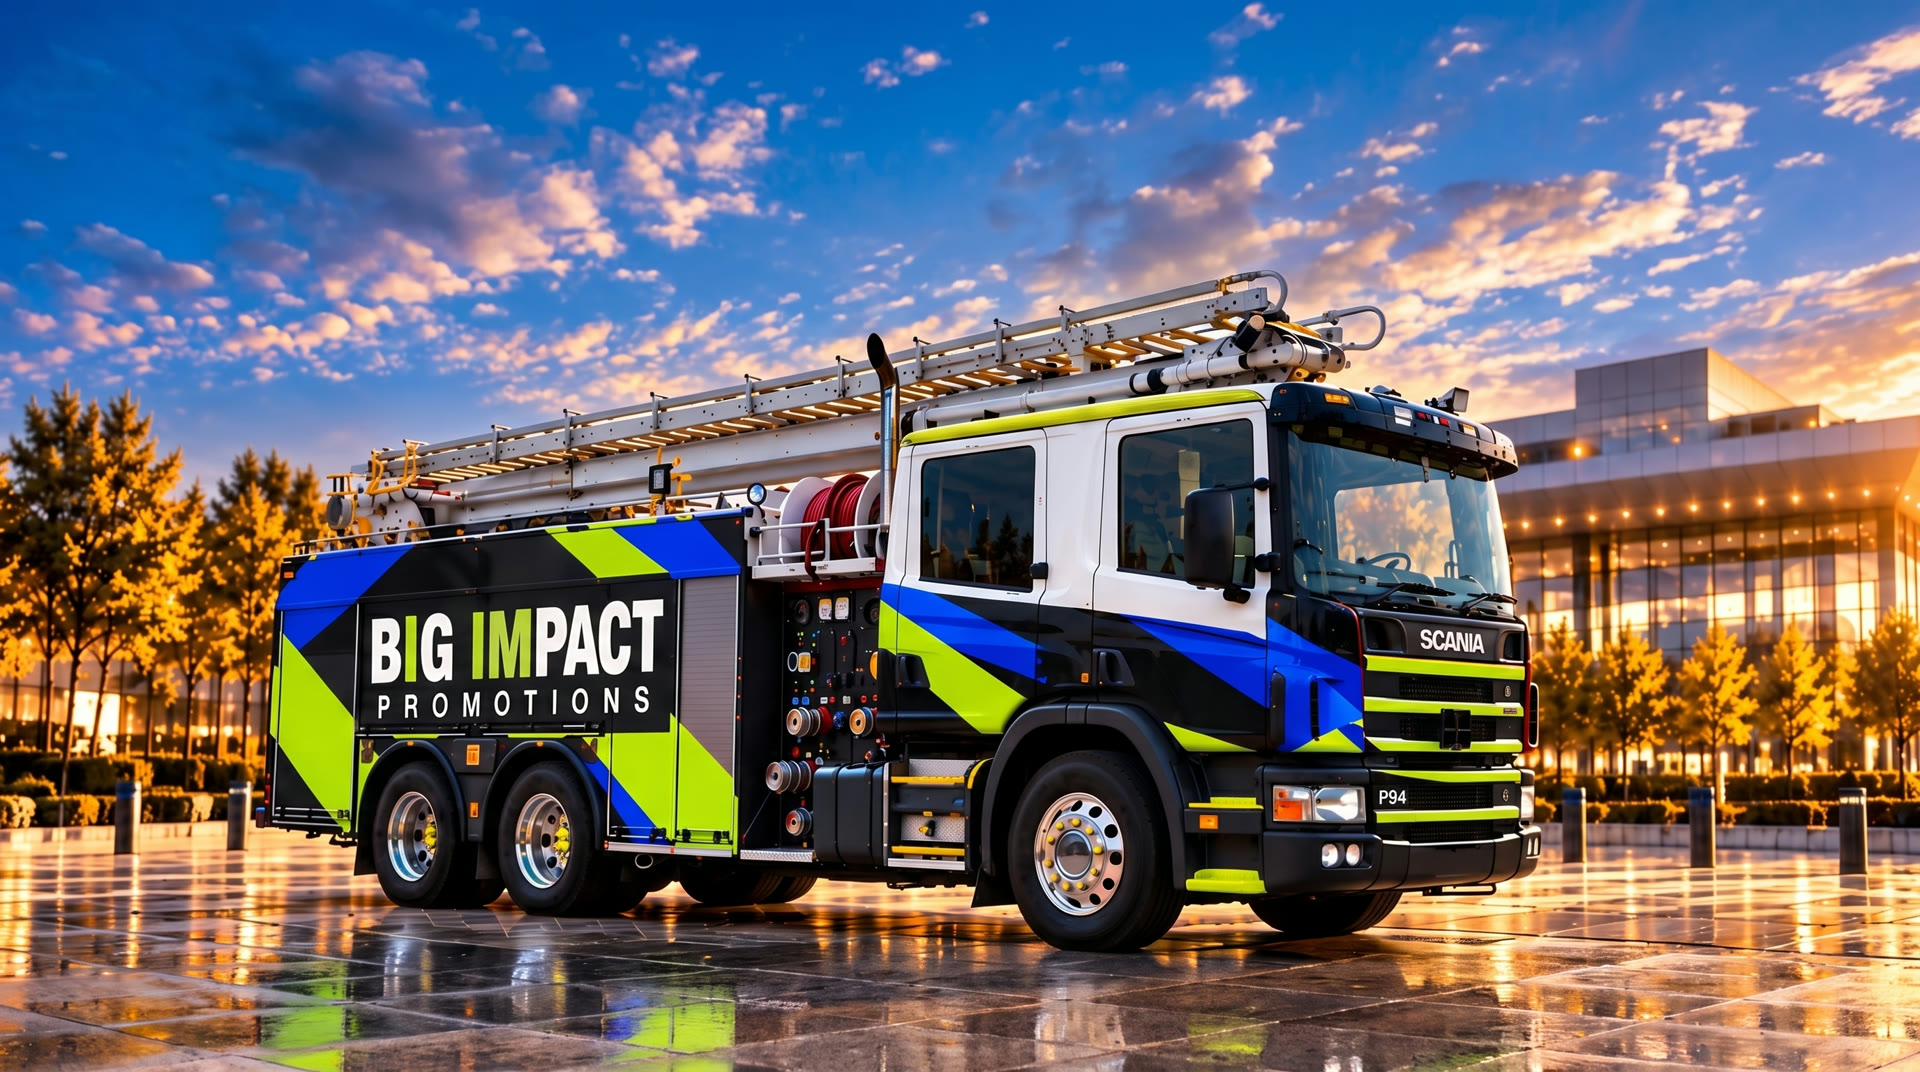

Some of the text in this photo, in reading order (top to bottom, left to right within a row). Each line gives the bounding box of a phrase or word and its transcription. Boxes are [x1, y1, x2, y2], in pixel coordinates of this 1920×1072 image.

[371, 599, 664, 684] BIG IMPACT
[1420, 629, 1485, 654] SCANIA
[377, 686, 650, 719] PROMOTIONS
[1378, 789, 1407, 805] P94
